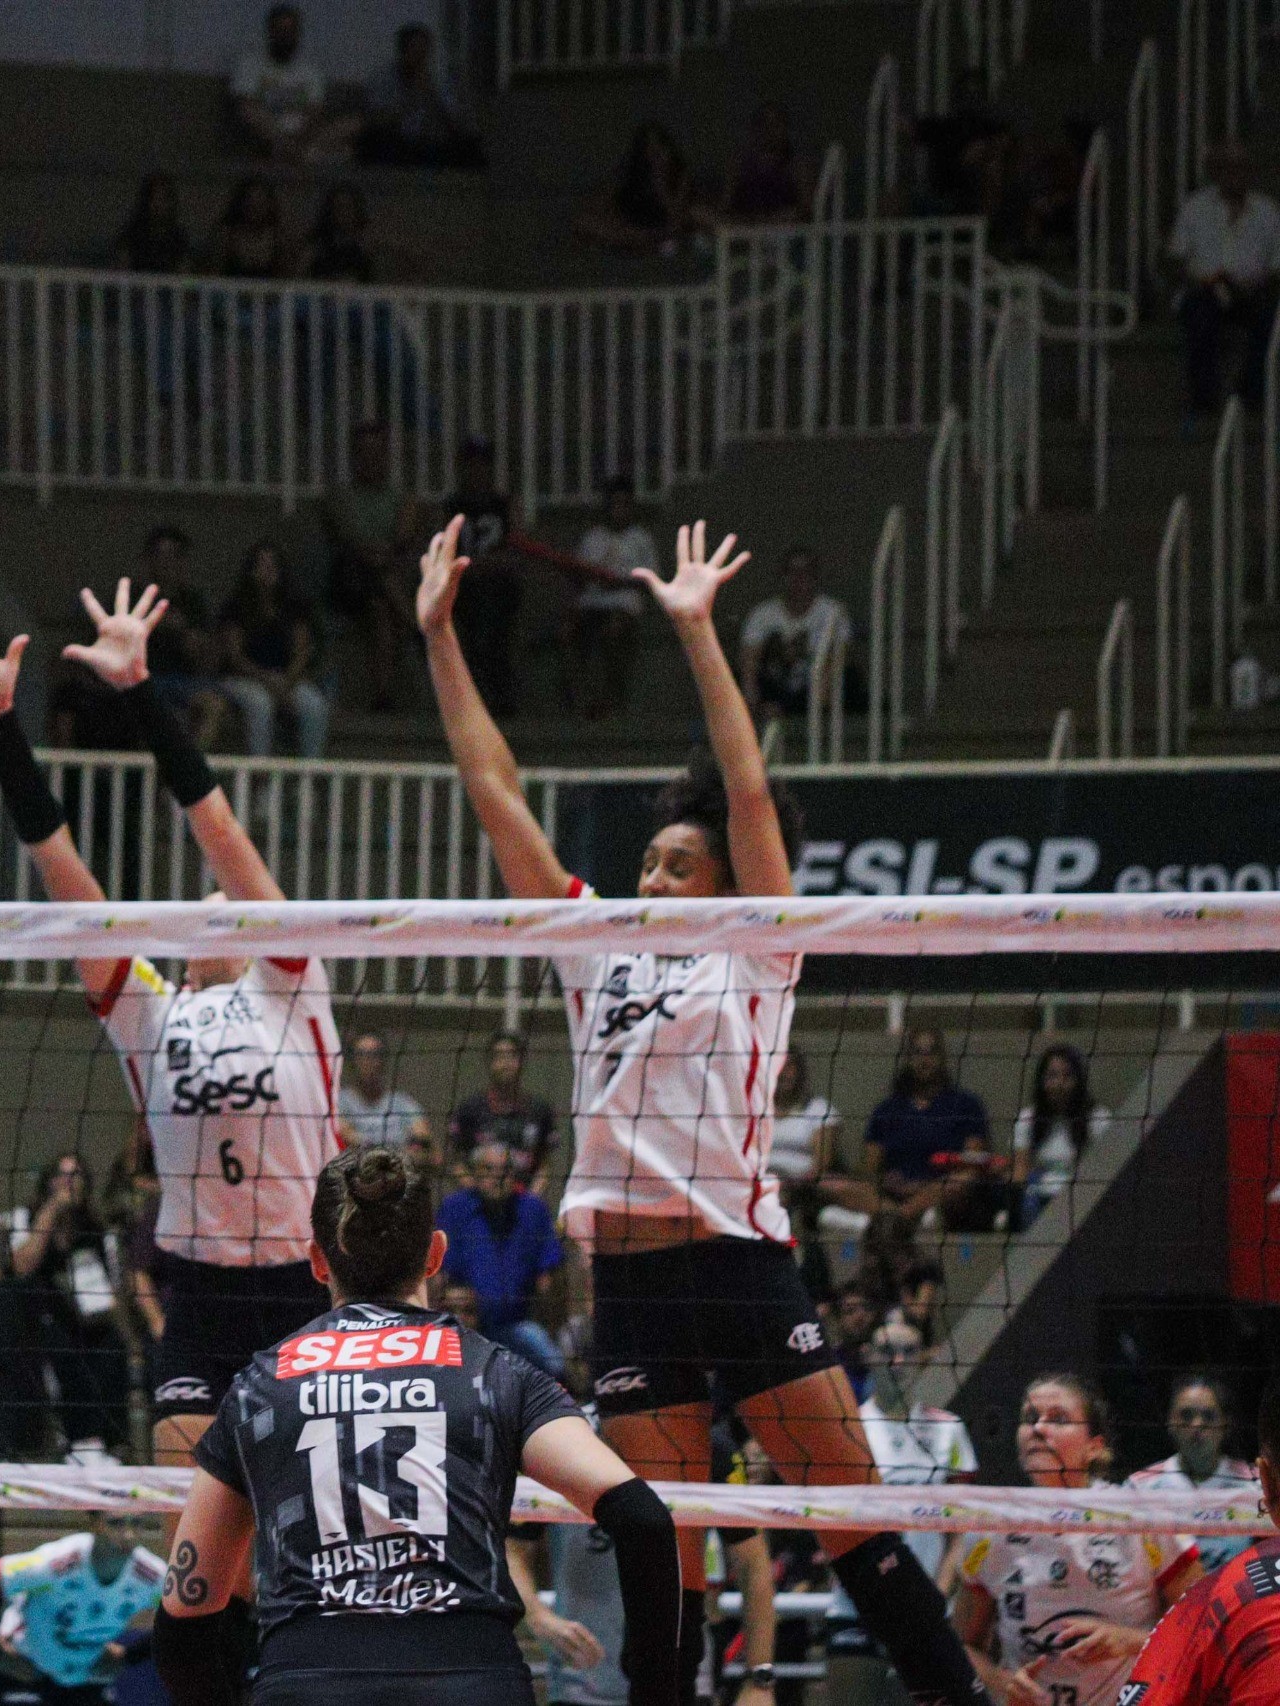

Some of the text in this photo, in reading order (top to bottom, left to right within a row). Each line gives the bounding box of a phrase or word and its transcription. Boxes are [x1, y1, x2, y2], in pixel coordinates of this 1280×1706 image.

[790, 837, 1280, 896] ESI-SP espo
[219, 1139, 245, 1186] 6
[290, 1328, 443, 1372] SESI
[298, 1373, 436, 1415] tilibra
[295, 1411, 448, 1546] 13
[311, 1538, 445, 1580] KASIELY
